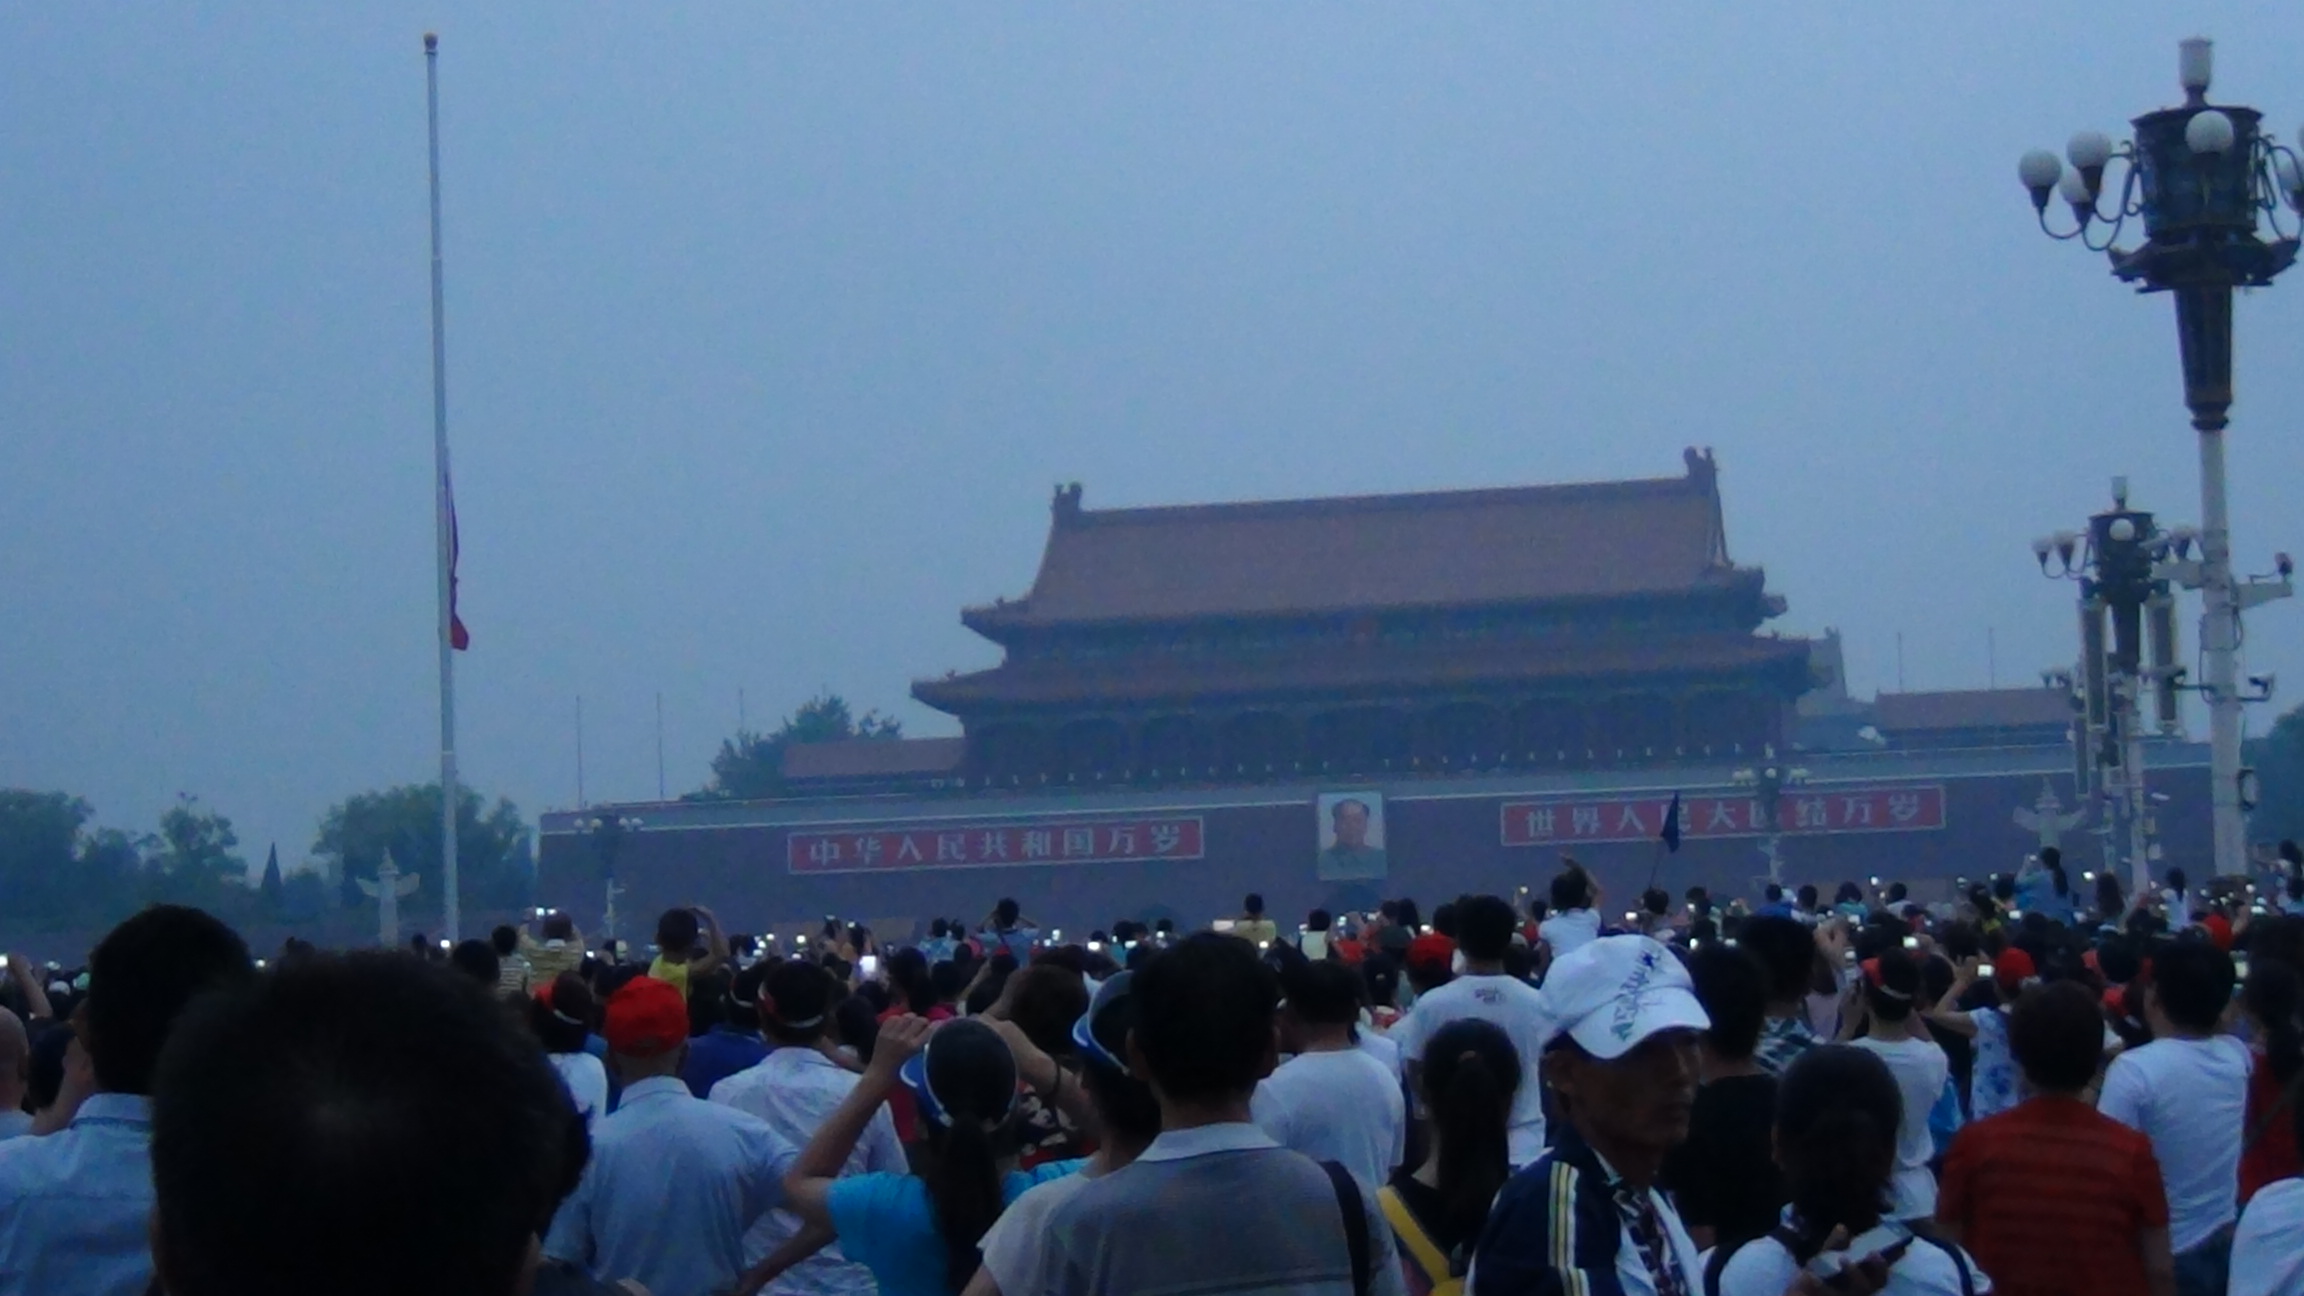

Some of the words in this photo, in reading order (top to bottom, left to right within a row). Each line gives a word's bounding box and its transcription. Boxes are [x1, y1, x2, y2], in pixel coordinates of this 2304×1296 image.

[809, 825, 1180, 866] 中华人民共和国万岁
